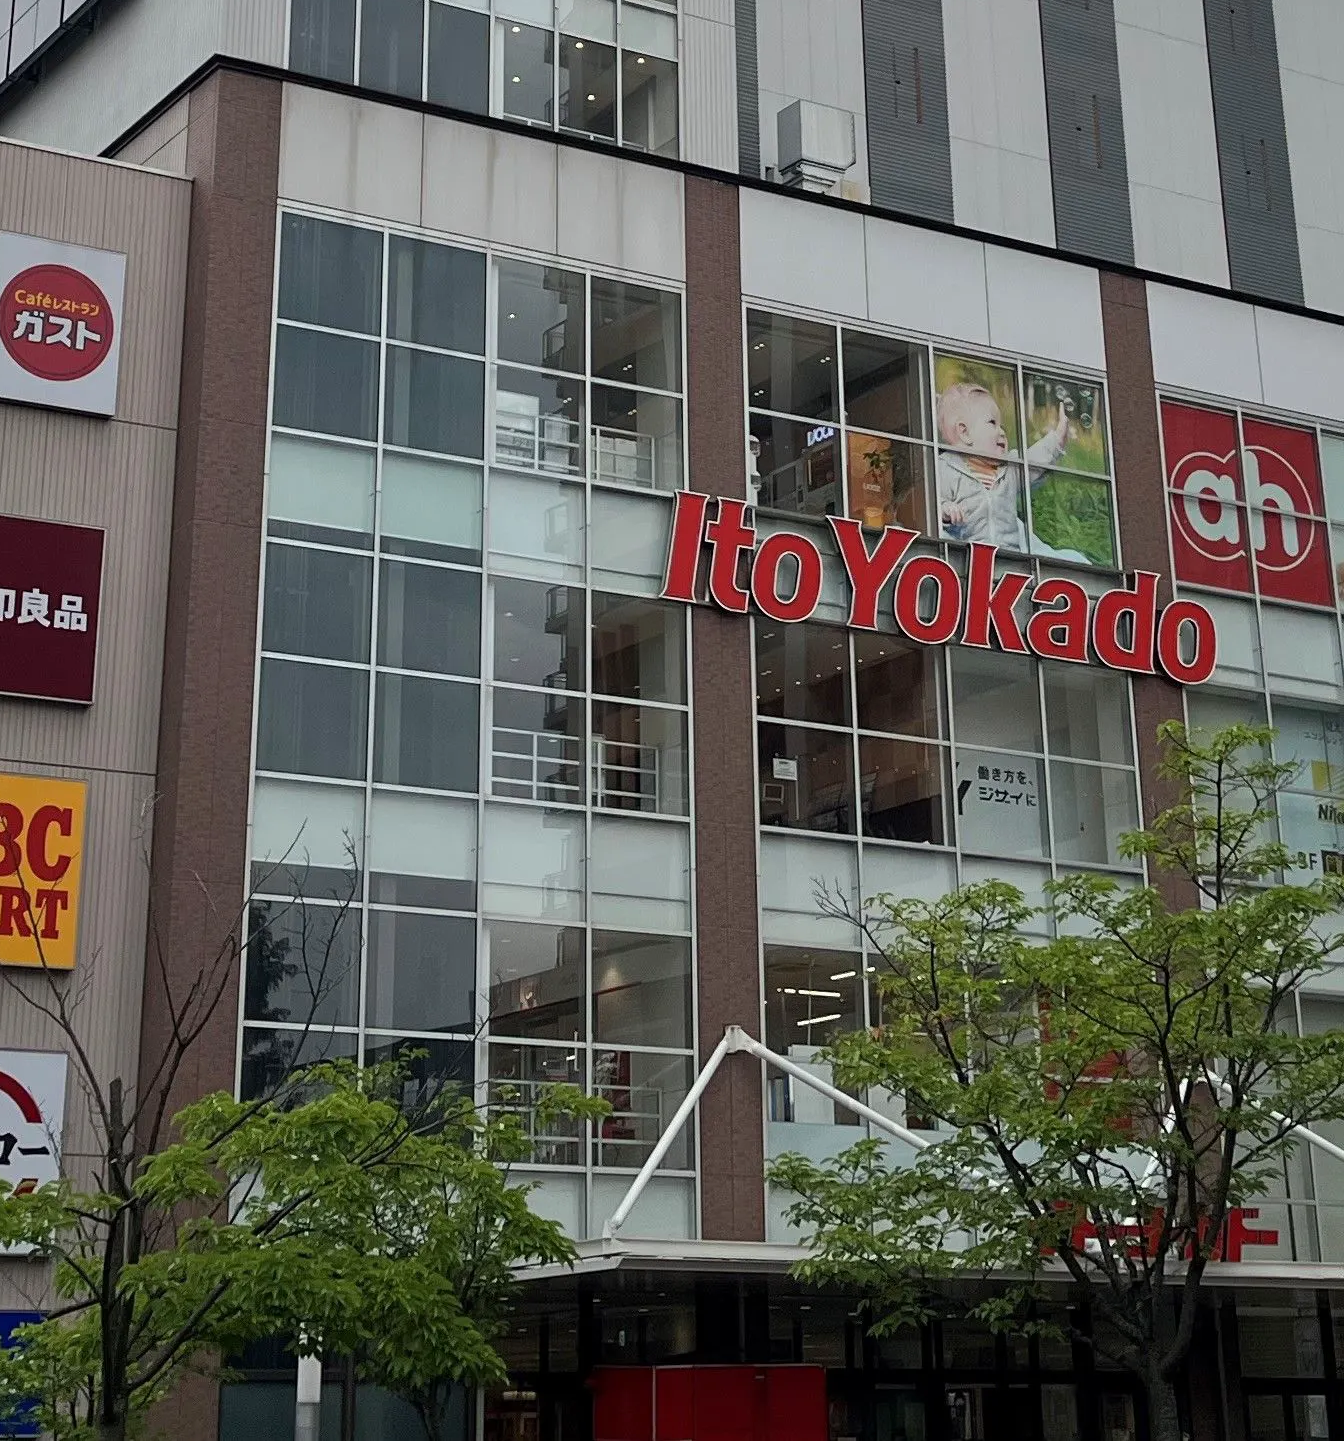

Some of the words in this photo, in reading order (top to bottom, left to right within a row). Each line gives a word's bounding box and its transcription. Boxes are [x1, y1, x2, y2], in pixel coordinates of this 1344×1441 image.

[12, 310, 101, 350] ガスト
[1183, 449, 1300, 557] ah
[659, 489, 824, 624] Ito
[826, 514, 1218, 685] Yokado
